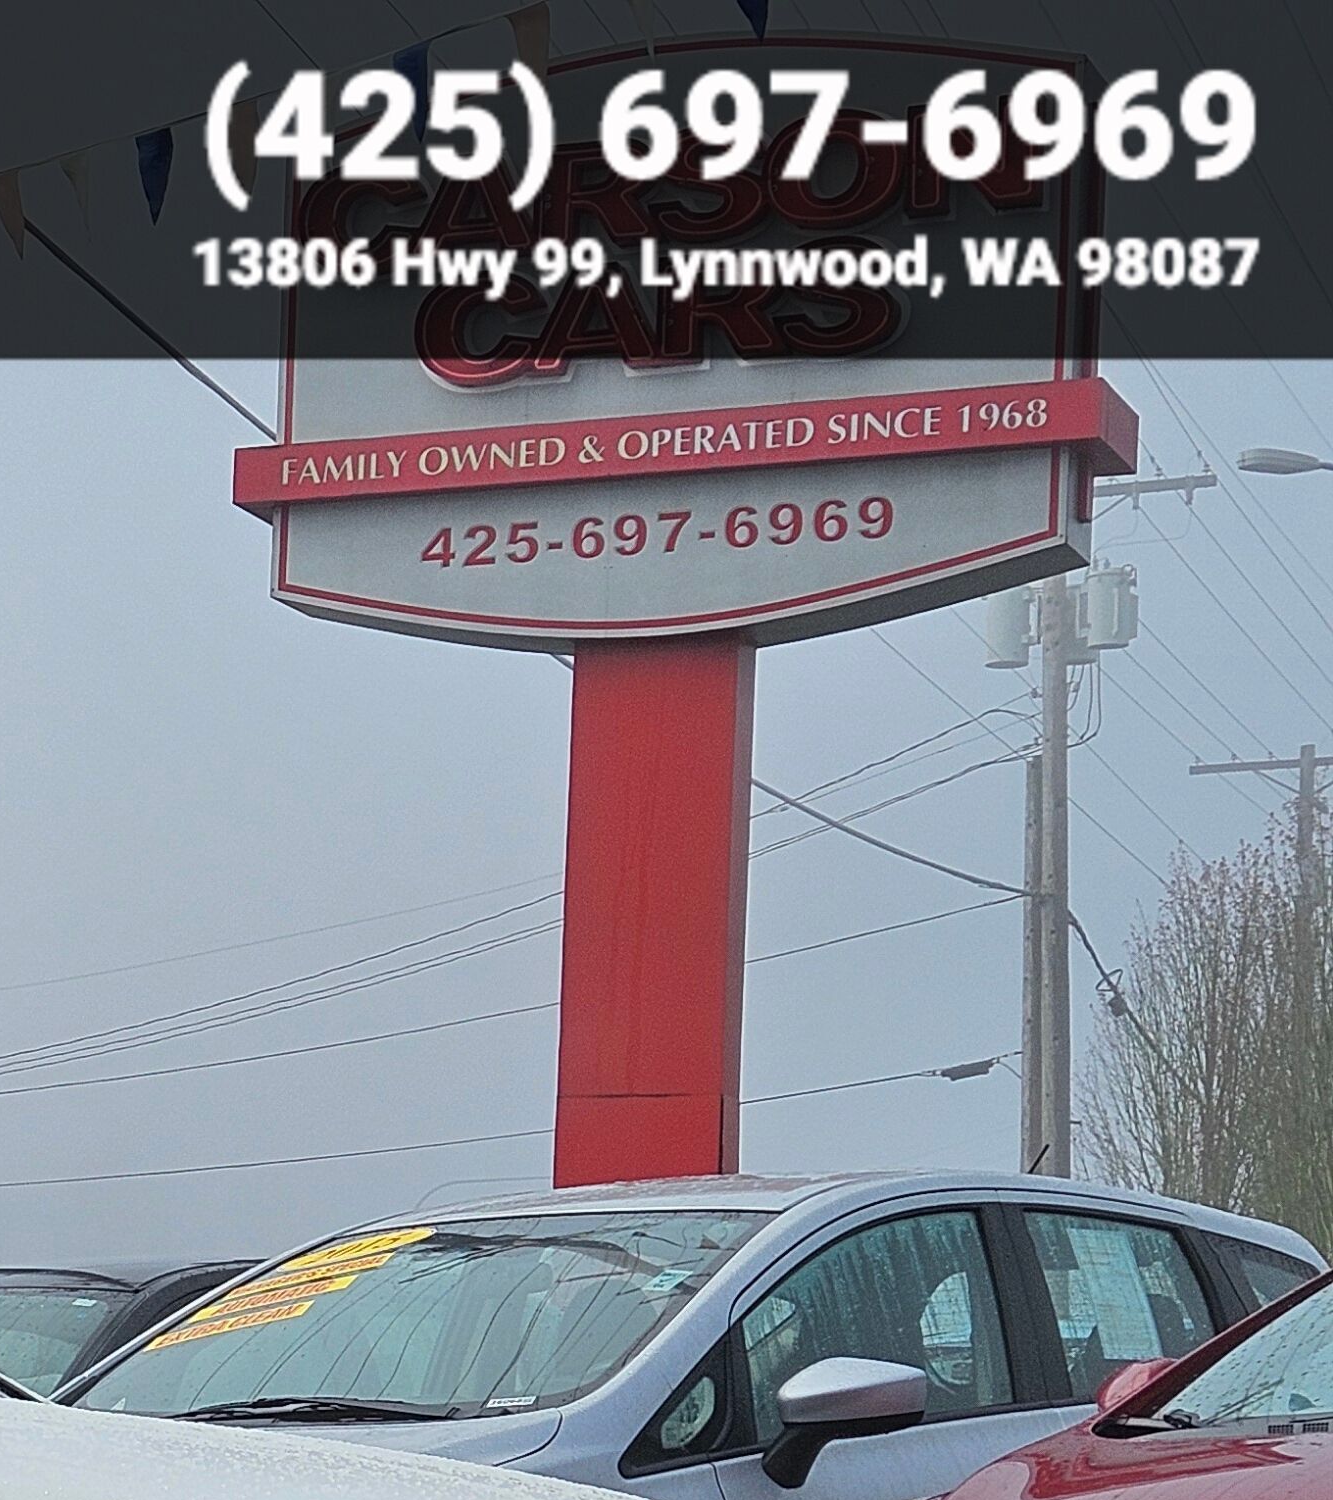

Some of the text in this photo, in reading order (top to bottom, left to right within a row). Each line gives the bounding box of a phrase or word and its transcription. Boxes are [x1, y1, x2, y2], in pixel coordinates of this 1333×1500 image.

[281, 398, 1049, 487] FAMILY OWNED & OPERATED SINCE 1968
[420, 496, 896, 570] 425-697-6969
[156, 1304, 305, 1346] EXTRA CLEAN
[211, 1280, 334, 1316] AUTOMATIC
